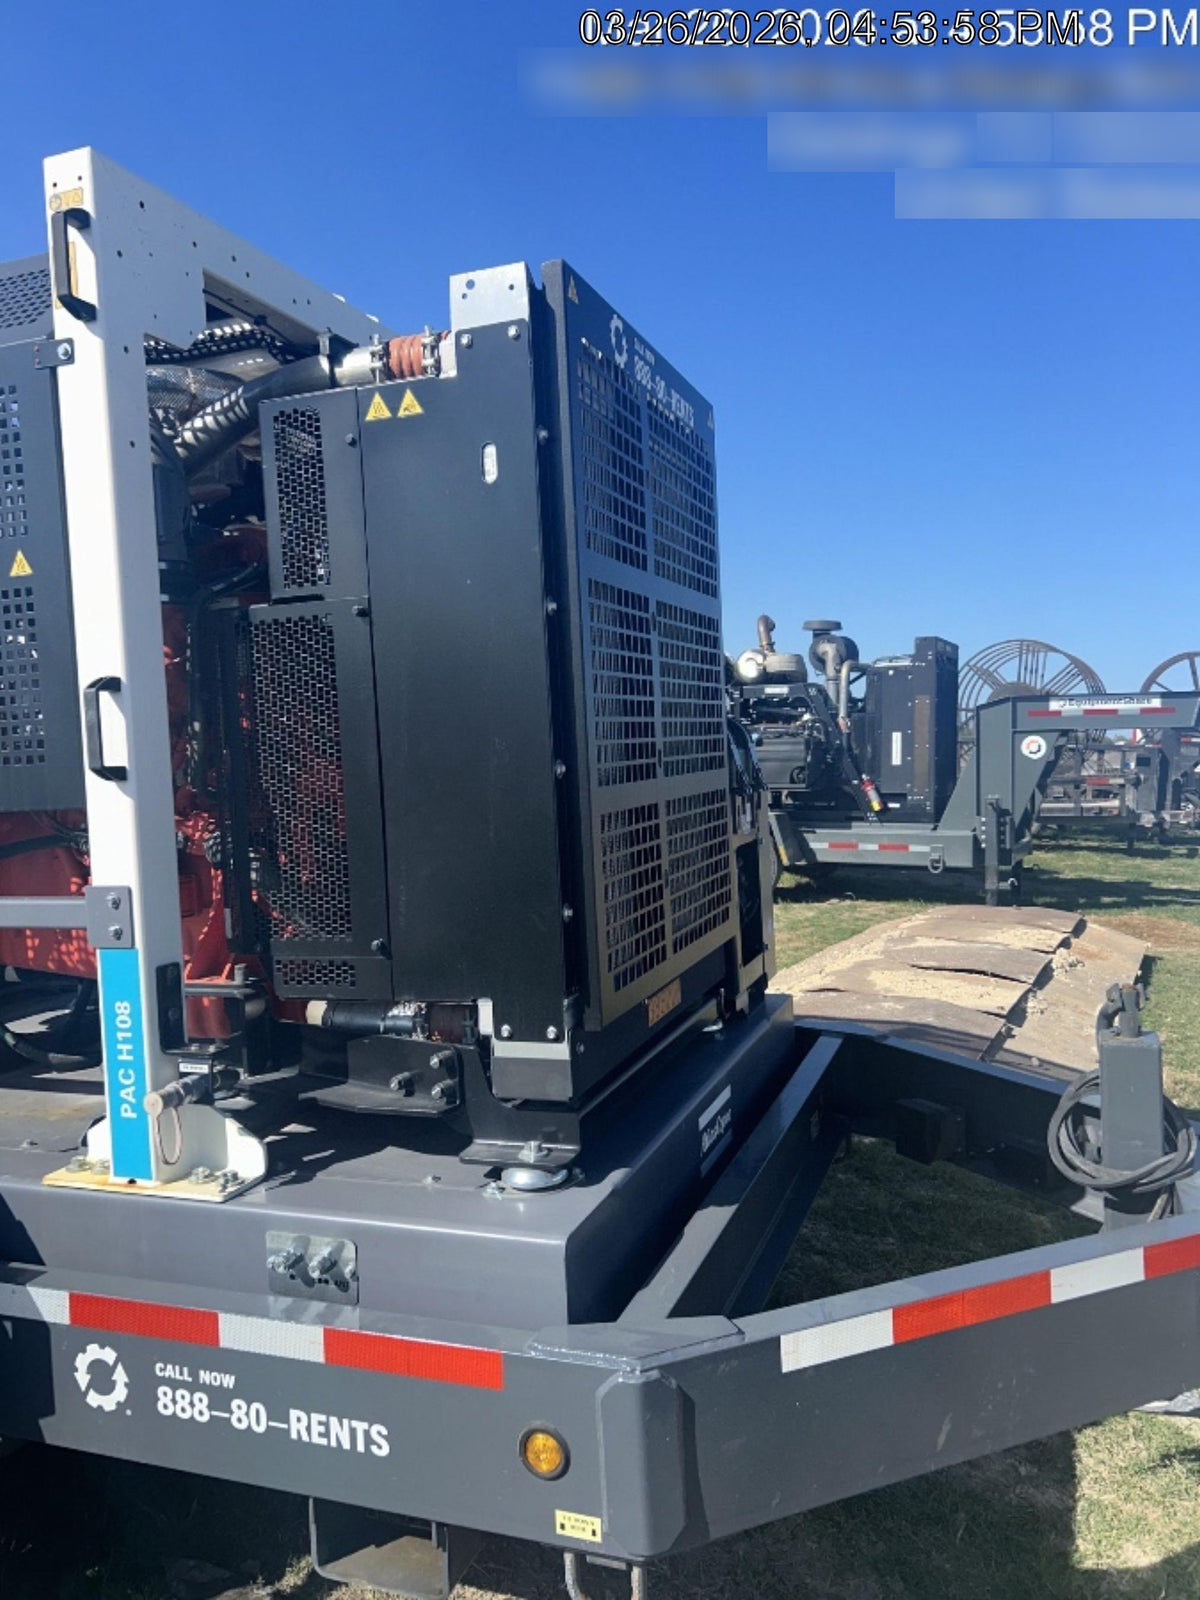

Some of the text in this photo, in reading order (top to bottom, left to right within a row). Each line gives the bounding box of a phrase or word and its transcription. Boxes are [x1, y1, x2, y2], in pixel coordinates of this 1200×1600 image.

[114, 1000, 138, 1119] PAC H108
[154, 1362, 236, 1390] CALL NOW
[156, 1385, 391, 1458] 888-80-RENTS
